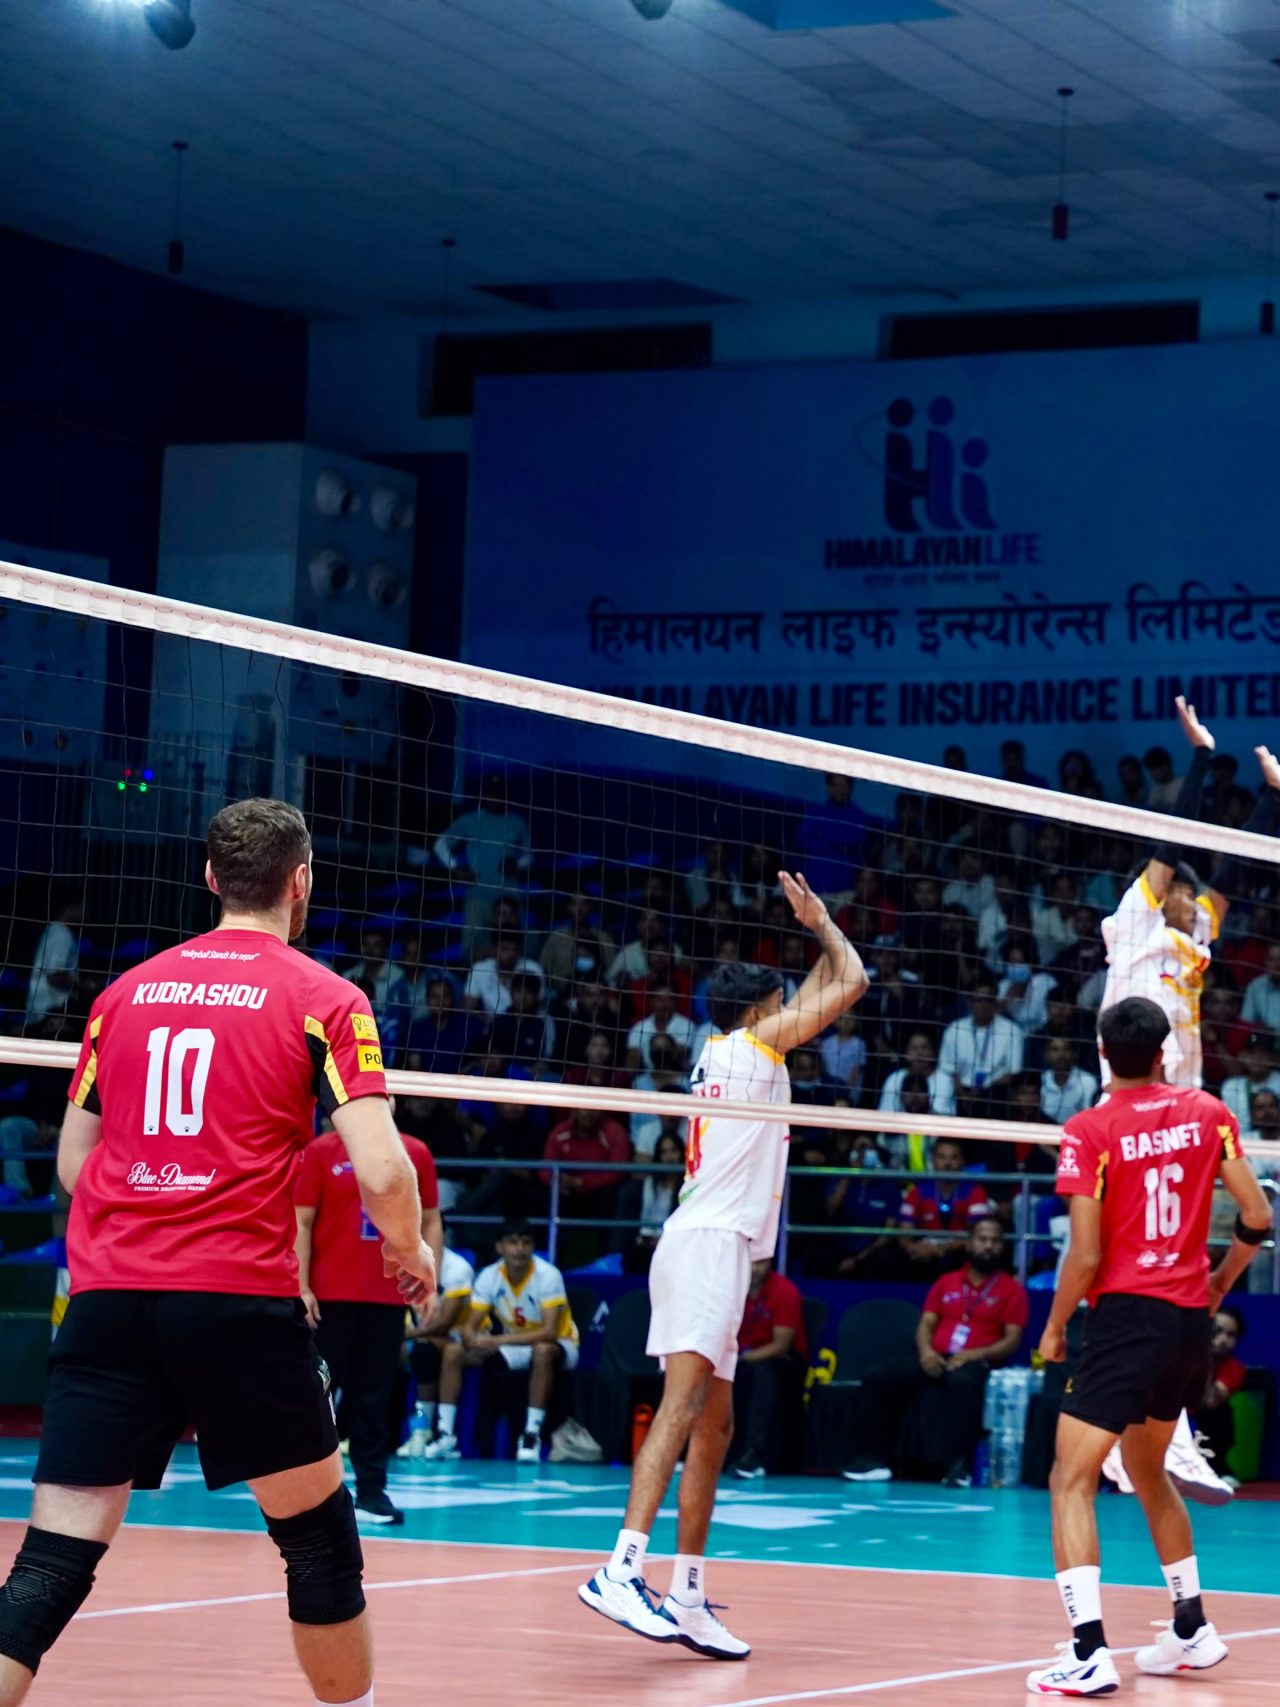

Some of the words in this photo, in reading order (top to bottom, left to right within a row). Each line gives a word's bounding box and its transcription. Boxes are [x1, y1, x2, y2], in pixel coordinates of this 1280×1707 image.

[588, 597, 764, 664] हिमालयन
[782, 610, 898, 659] लाइफ
[810, 683, 886, 726] LIFE
[900, 679, 1119, 726] INSURANCE
[143, 1026, 216, 1136] 10
[1120, 1121, 1202, 1162] BASNET
[127, 1162, 157, 1185] Blue
[157, 1163, 216, 1186] Diamond
[1144, 1162, 1184, 1241] 16
